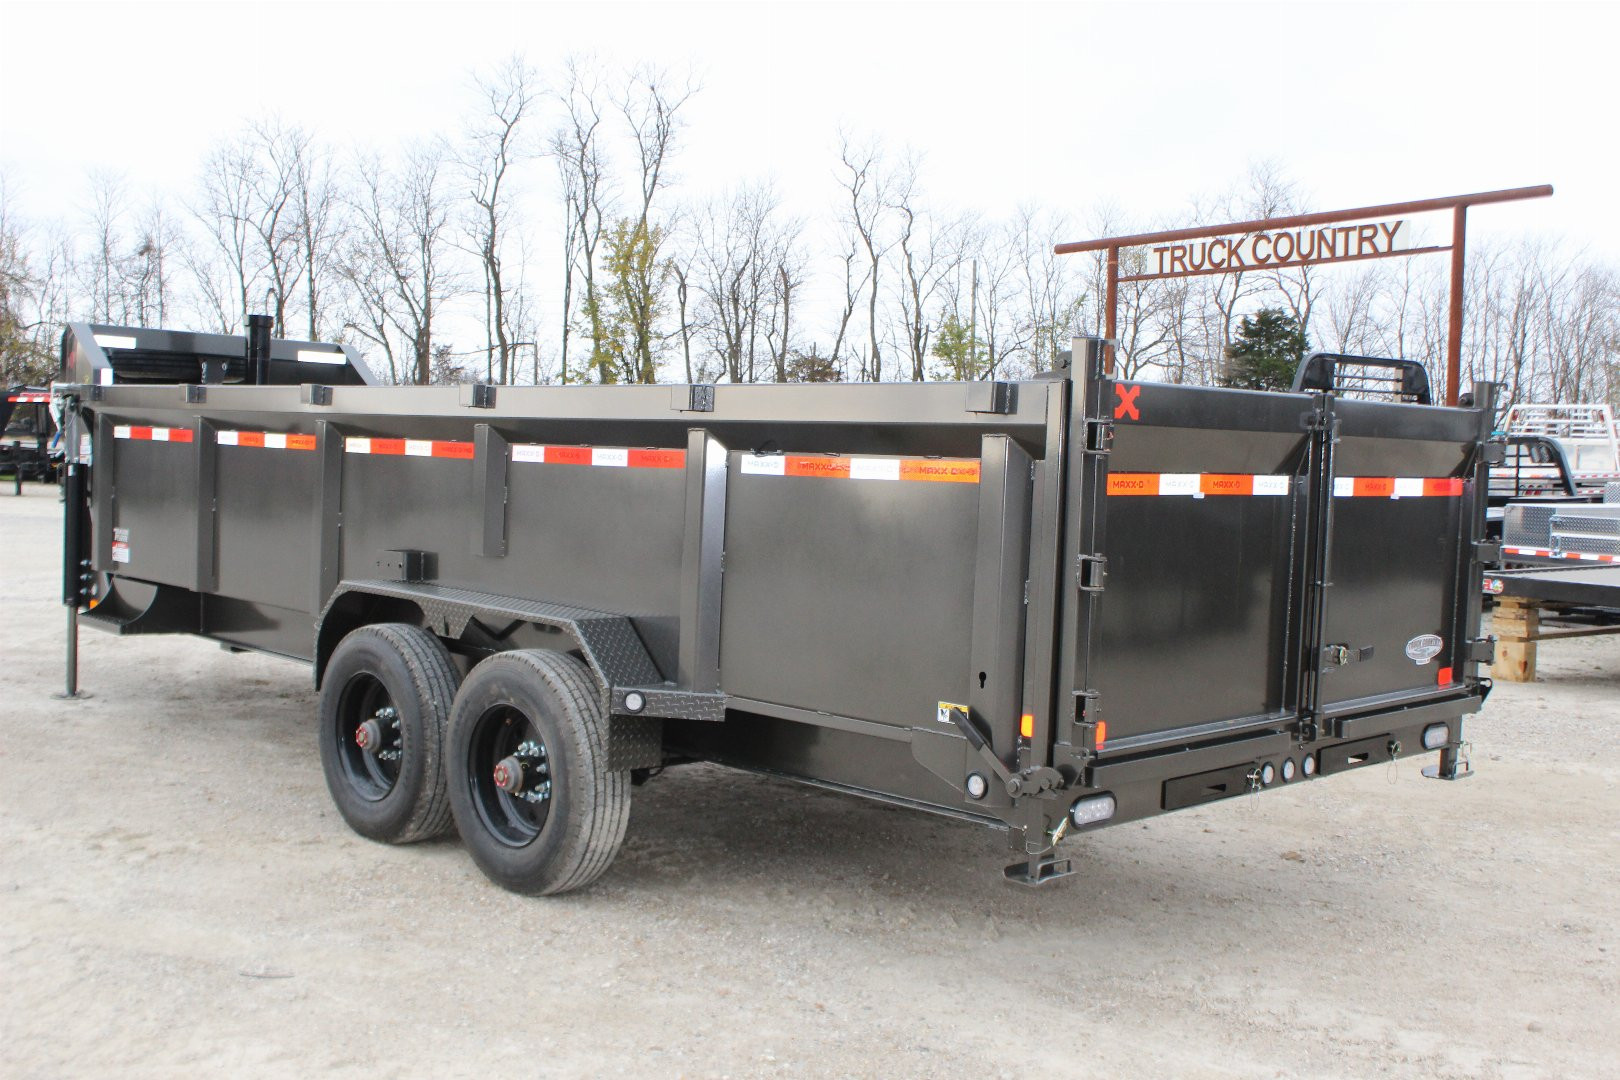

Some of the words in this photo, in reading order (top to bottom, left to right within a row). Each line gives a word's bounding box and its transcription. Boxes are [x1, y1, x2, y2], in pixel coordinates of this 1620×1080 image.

[1153, 238, 1245, 274] TRUCK
[1251, 220, 1403, 265] COUNTRY
[1114, 384, 1140, 420] X
